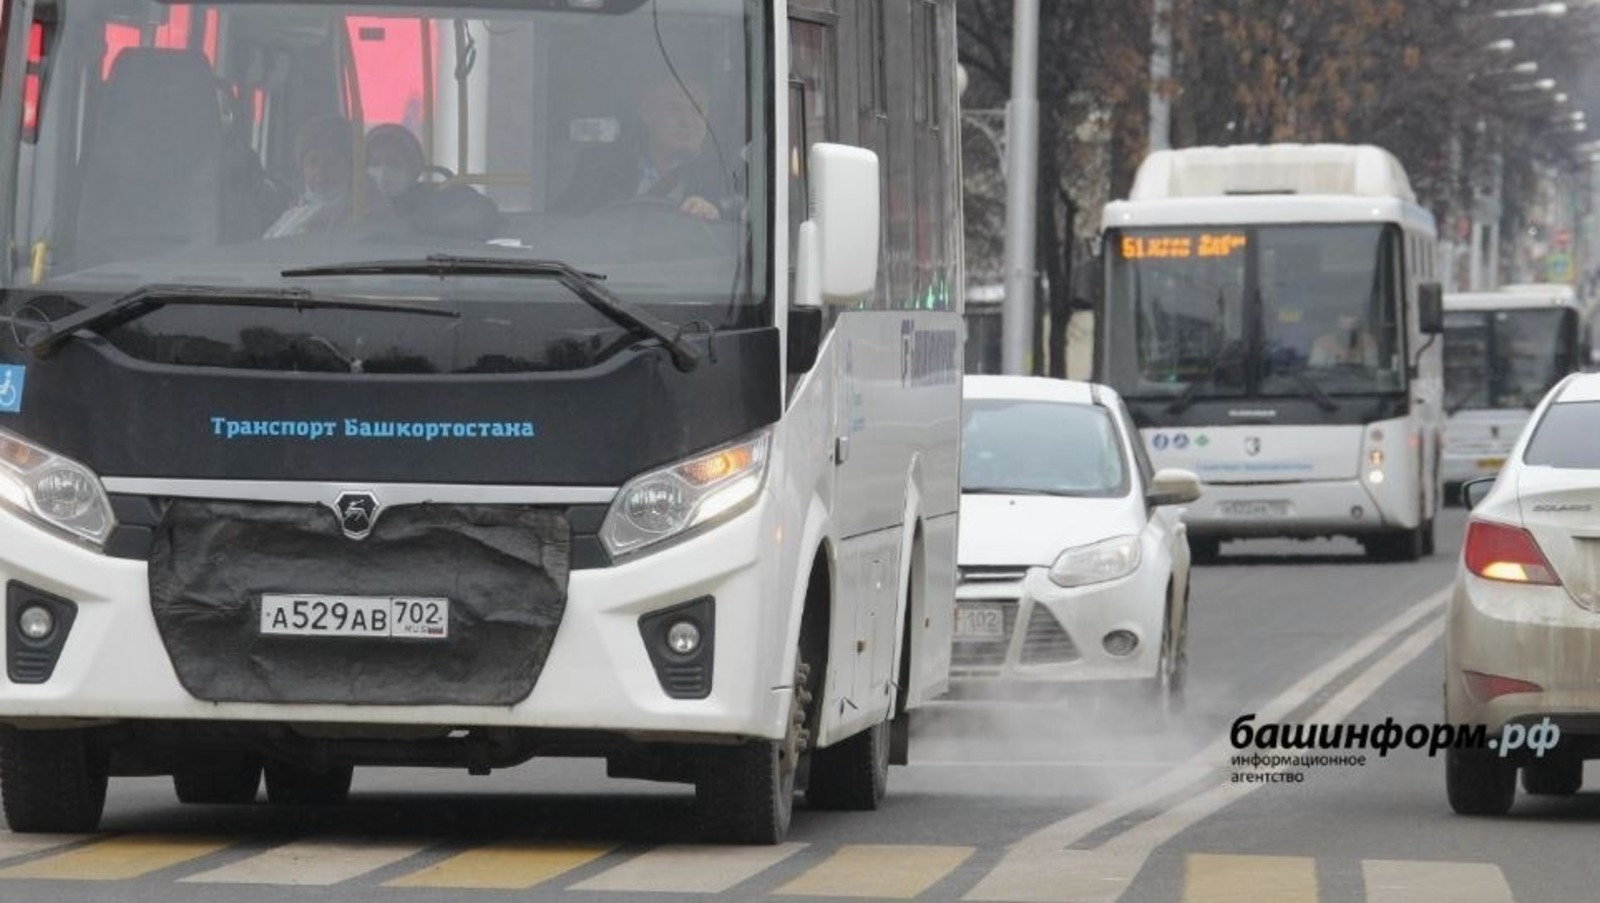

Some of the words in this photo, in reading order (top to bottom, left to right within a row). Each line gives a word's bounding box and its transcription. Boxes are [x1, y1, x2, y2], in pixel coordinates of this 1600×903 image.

[211, 417, 336, 439] Транспорт
[344, 418, 534, 440] Башкортостана
[394, 602, 439, 625] 702
[967, 611, 998, 630] 102
